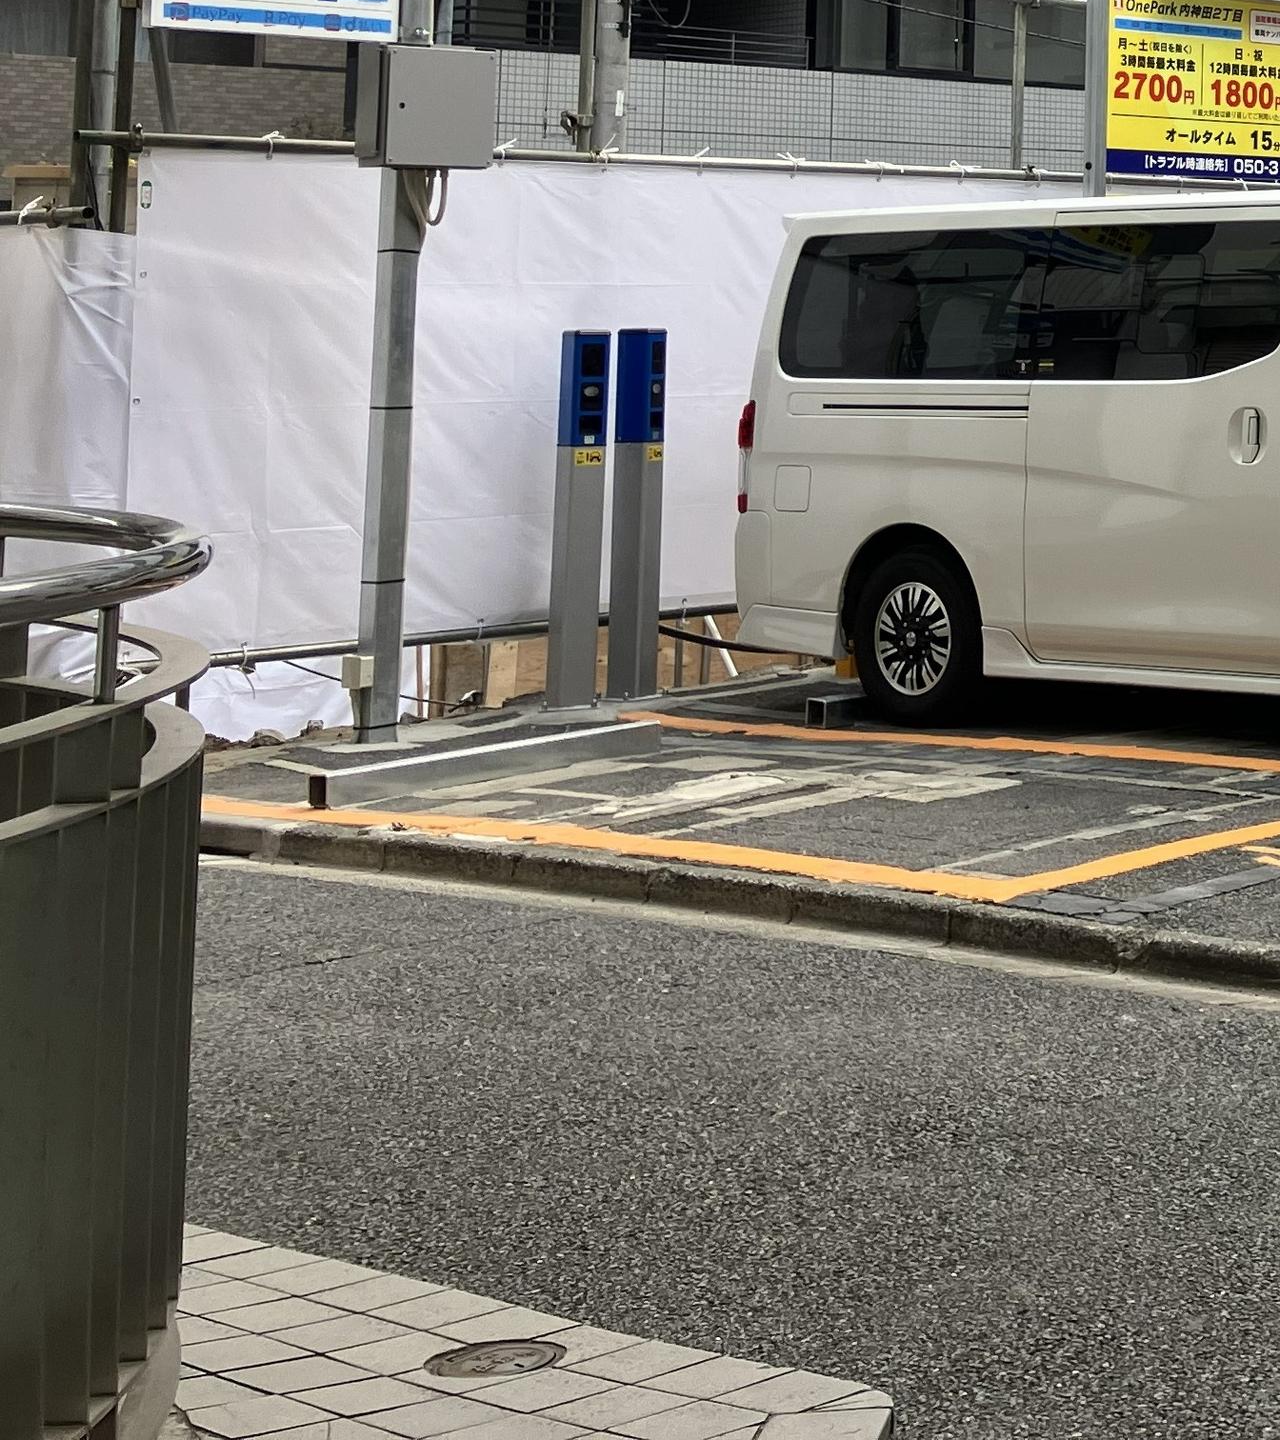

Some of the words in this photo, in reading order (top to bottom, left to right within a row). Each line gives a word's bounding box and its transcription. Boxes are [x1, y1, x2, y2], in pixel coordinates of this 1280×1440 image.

[1180, 5, 1243, 22] 内神田2丁目
[1121, 54, 1196, 72] 3時間毎最大料金
[1165, 128, 1236, 146] オールタイム
